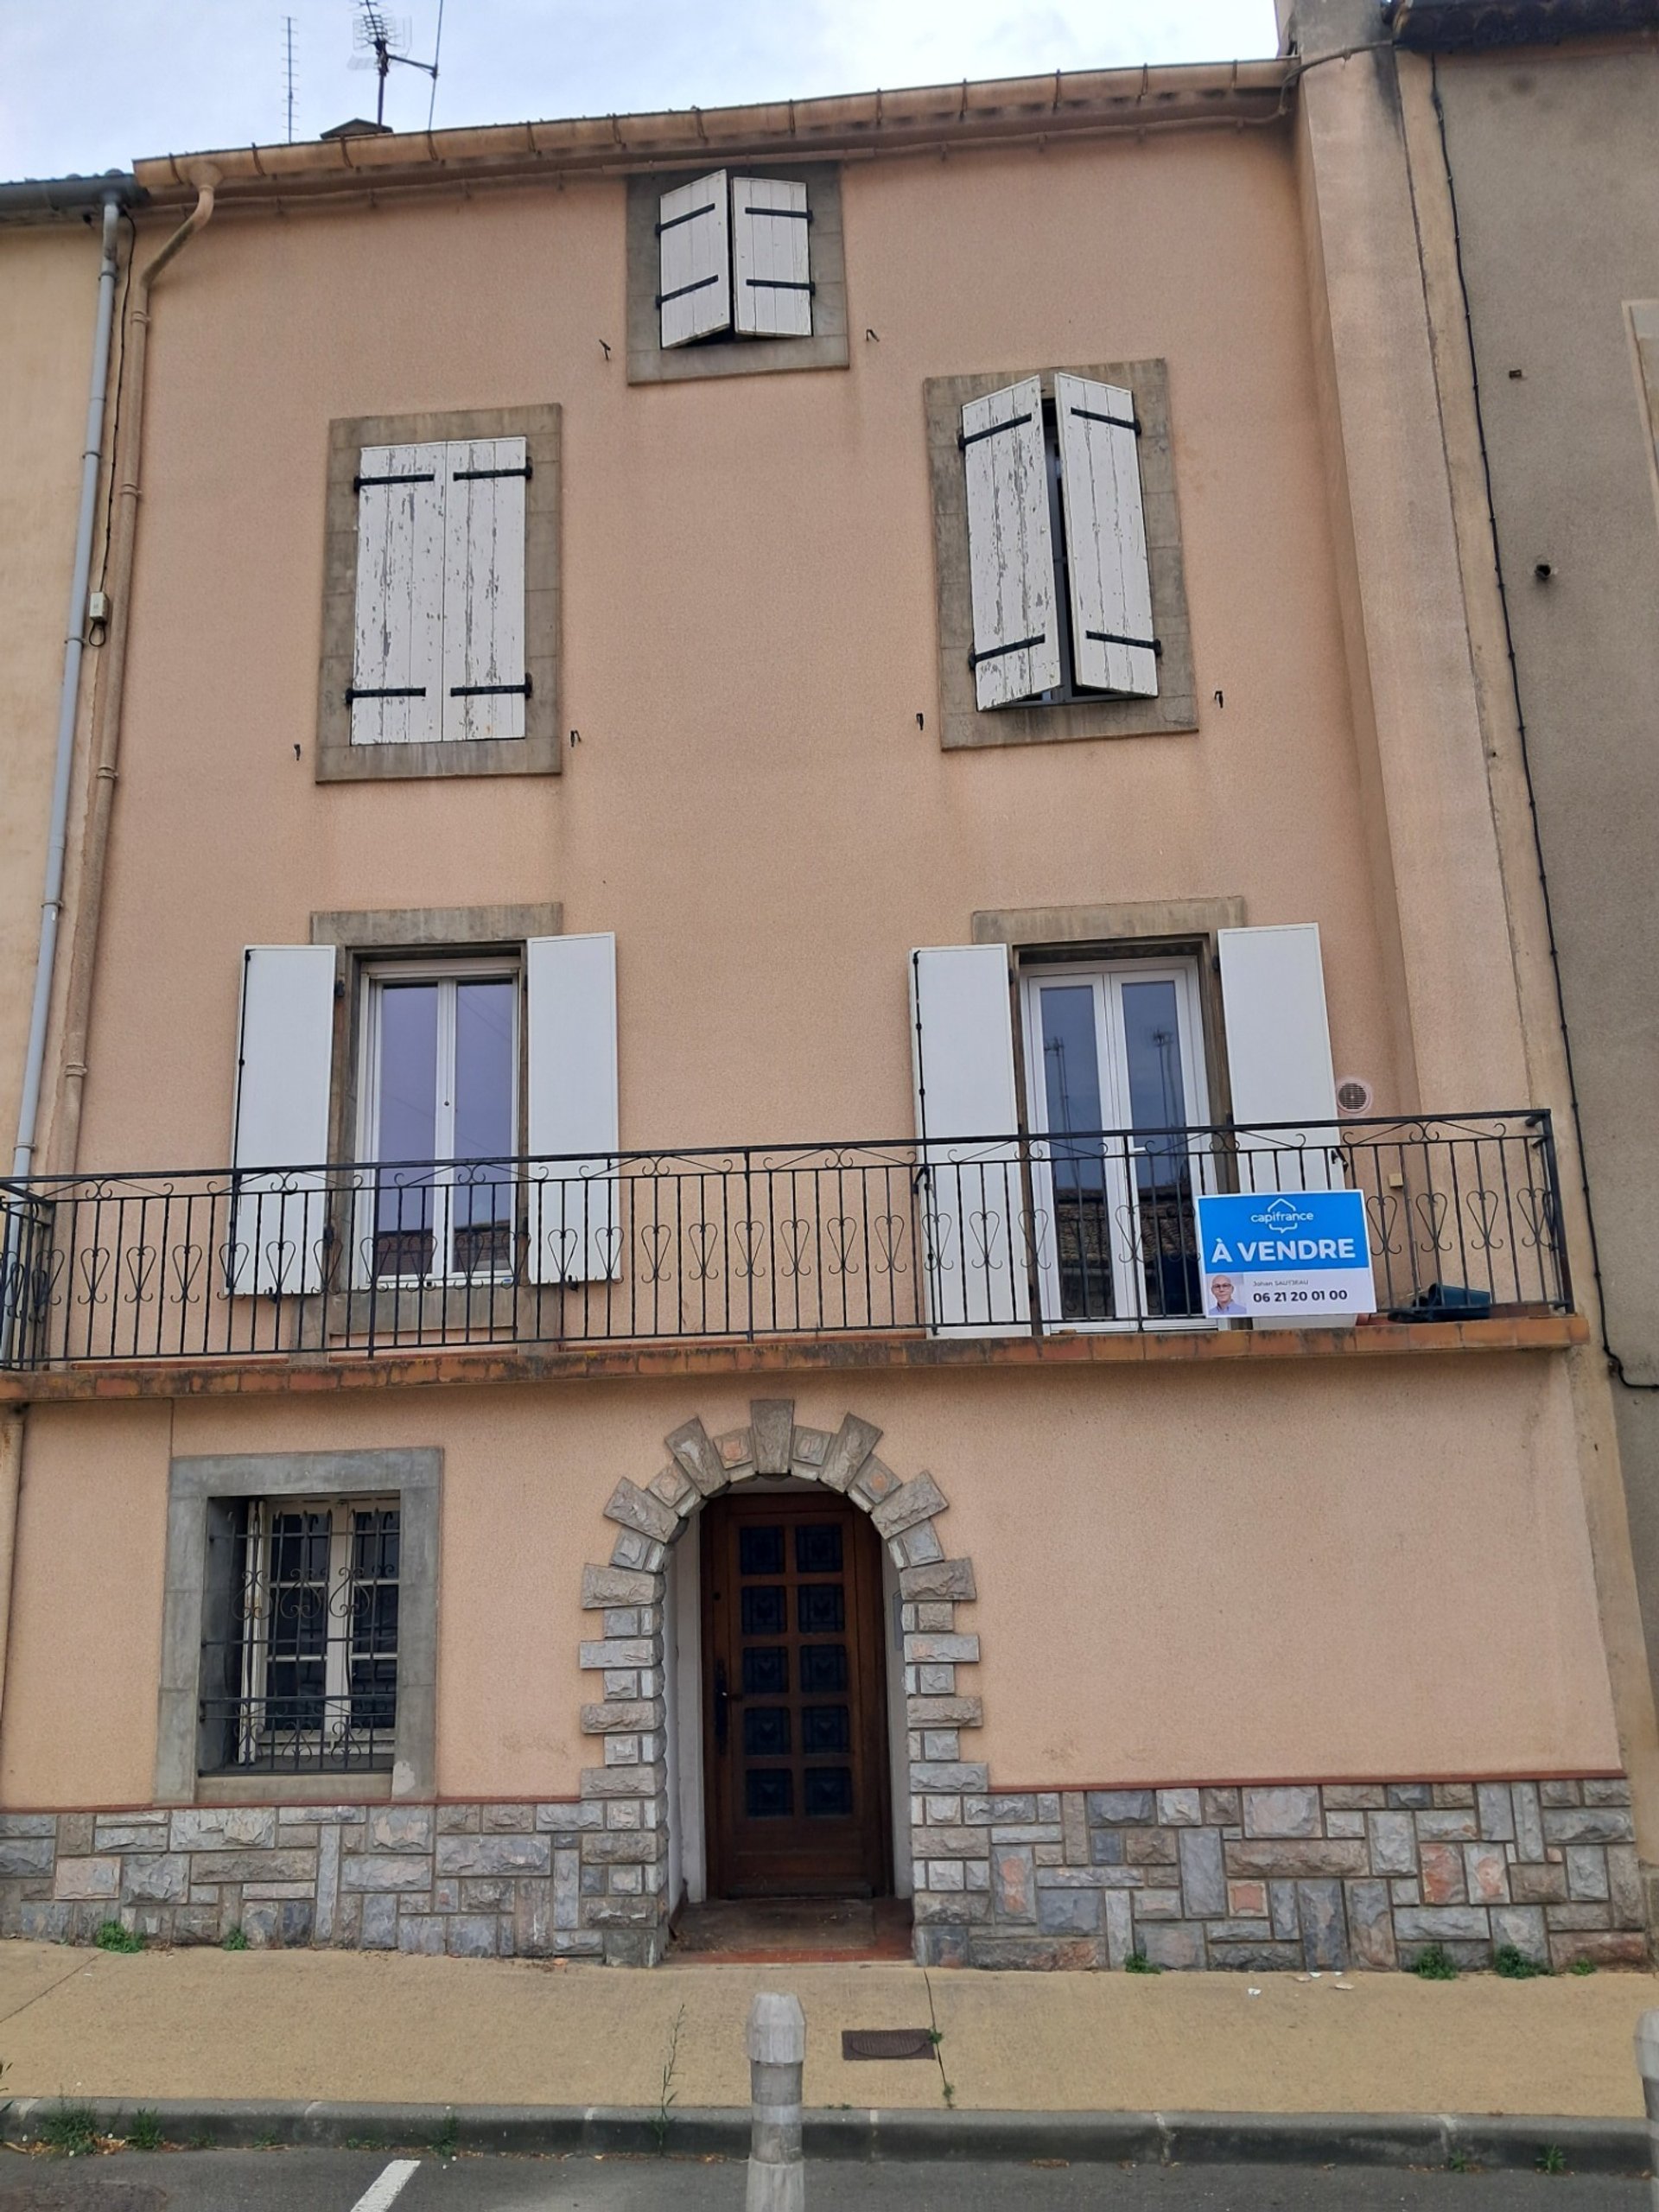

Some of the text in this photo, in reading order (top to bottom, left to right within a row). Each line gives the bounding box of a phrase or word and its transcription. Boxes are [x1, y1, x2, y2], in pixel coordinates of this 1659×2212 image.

[1250, 1211, 1313, 1224] capifrance
[1211, 1237, 1356, 1262] À VENDRE
[1253, 1289, 1348, 1303] 06 21 20 01 00
